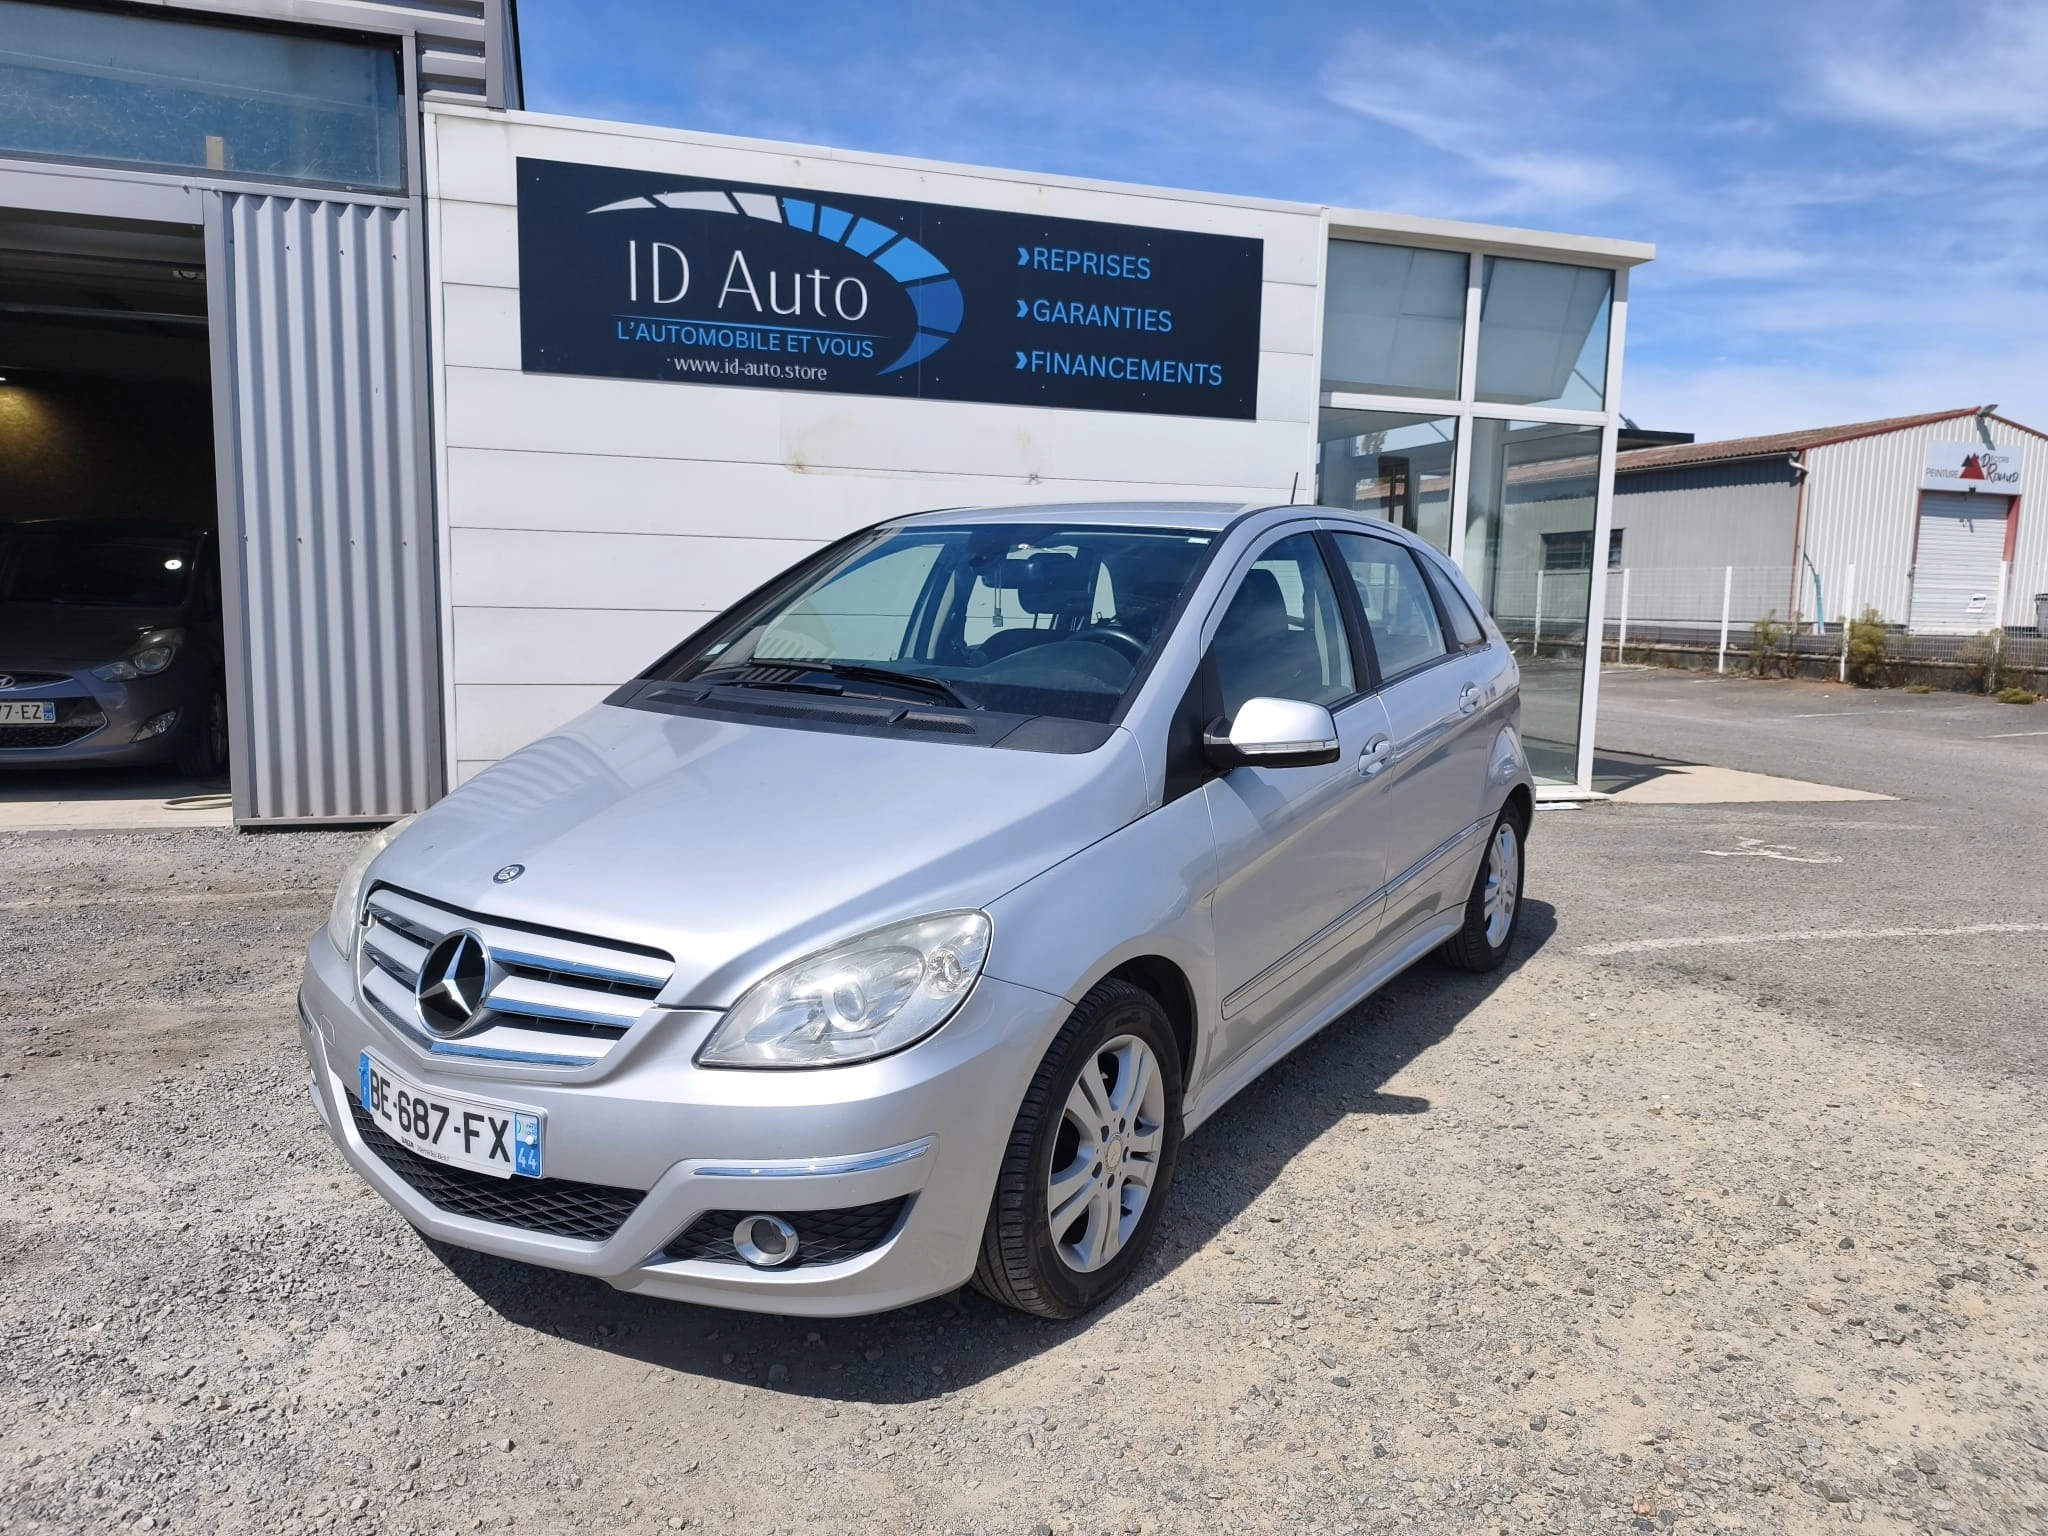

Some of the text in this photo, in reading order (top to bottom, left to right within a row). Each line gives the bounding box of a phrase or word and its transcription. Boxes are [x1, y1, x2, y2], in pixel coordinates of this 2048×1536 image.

[1033, 247, 1151, 279] REPRISES
[629, 239, 869, 321] ID Auto
[1033, 299, 1173, 332] GARANTIES
[616, 320, 874, 359] L'AUTOMOBILE ET VOUS
[674, 357, 828, 382] www.id-auto.store
[1031, 350, 1223, 386] FINANCEMENTS
[1925, 467, 1959, 479] PEINTURE
[0, 704, 41, 720] 7-EZ
[370, 1068, 511, 1163] BE-687-FX
[517, 1147, 537, 1170] 44
